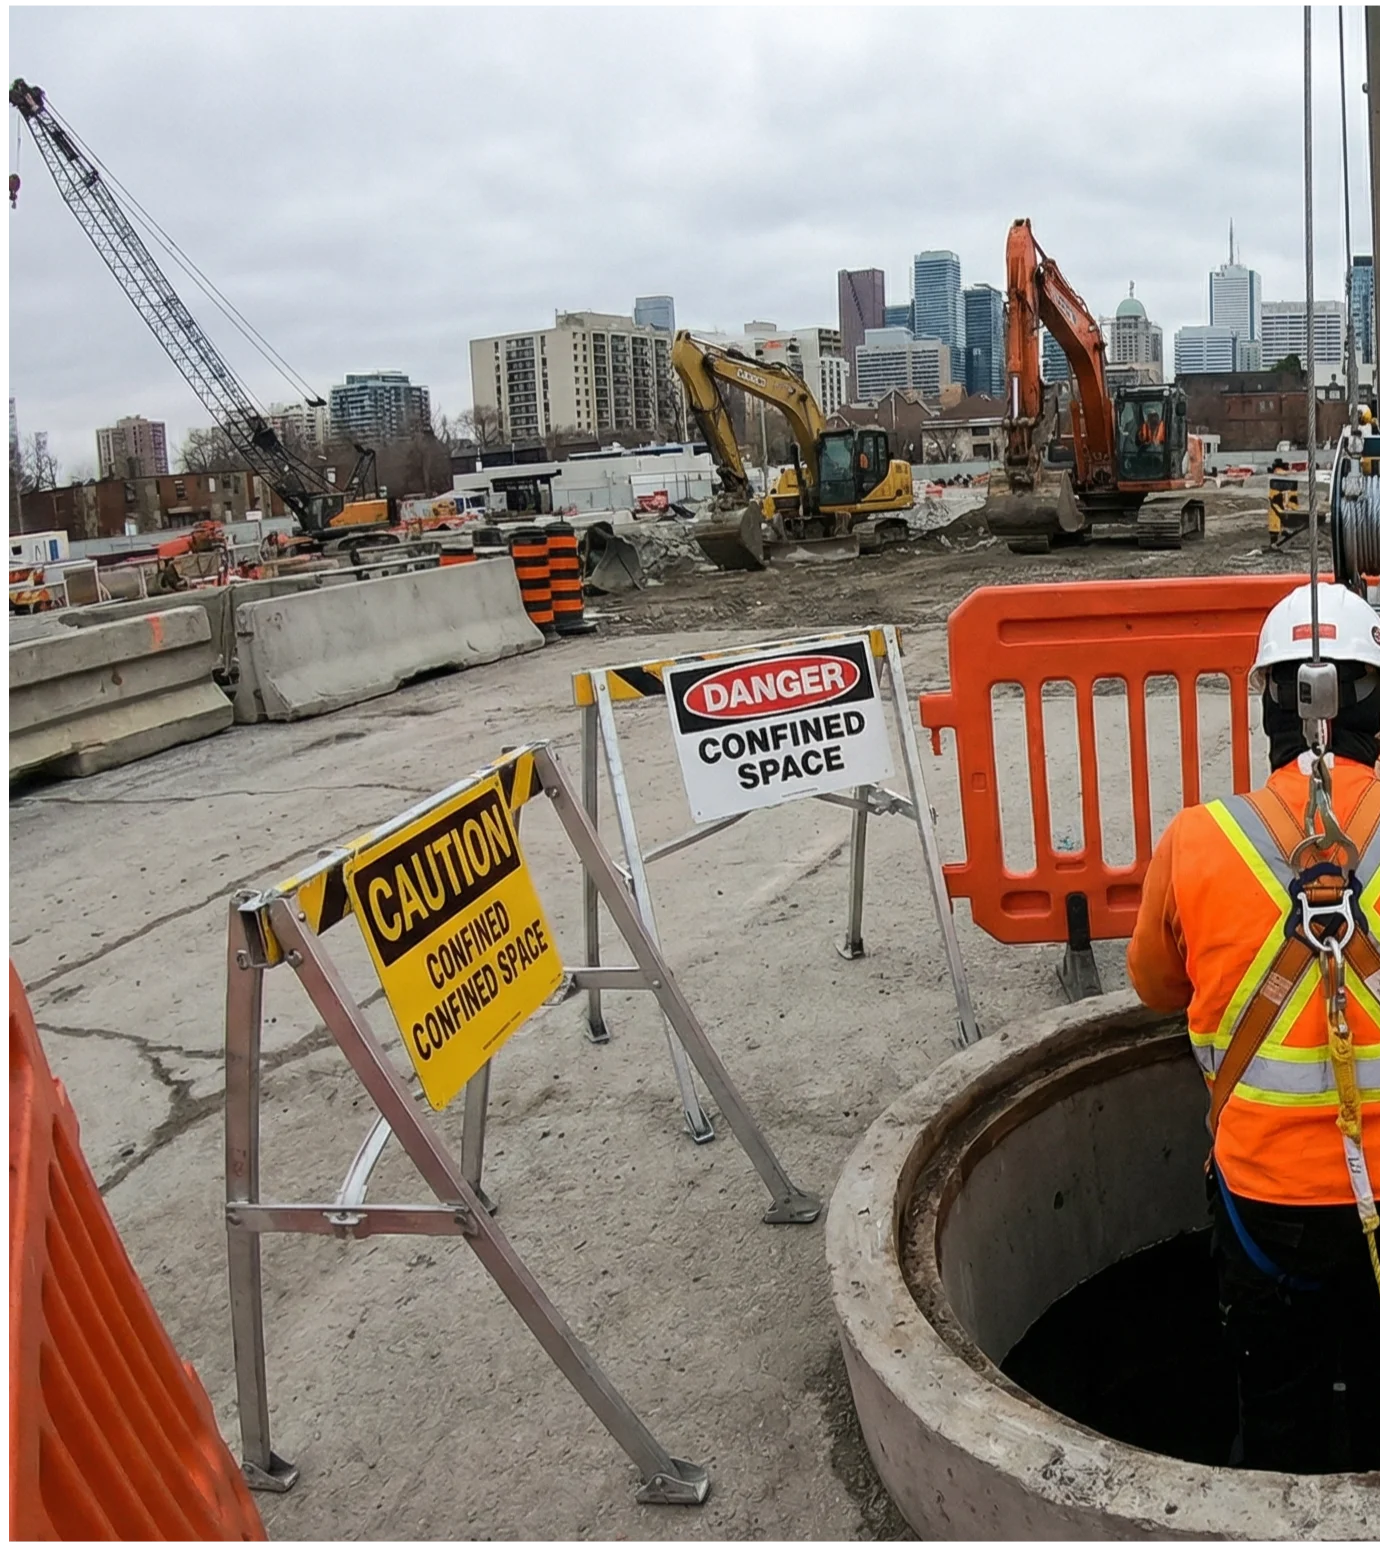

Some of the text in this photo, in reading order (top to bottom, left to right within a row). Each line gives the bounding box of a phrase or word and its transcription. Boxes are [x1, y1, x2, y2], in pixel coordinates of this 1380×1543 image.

[703, 662, 845, 712] DANGER
[698, 711, 865, 764] CONFINED
[738, 746, 845, 789] SPACE
[368, 804, 511, 942] CAUTION
[426, 900, 510, 990] CONFINED
[412, 964, 499, 1061] CONFINED
[497, 919, 548, 985] SPACE
